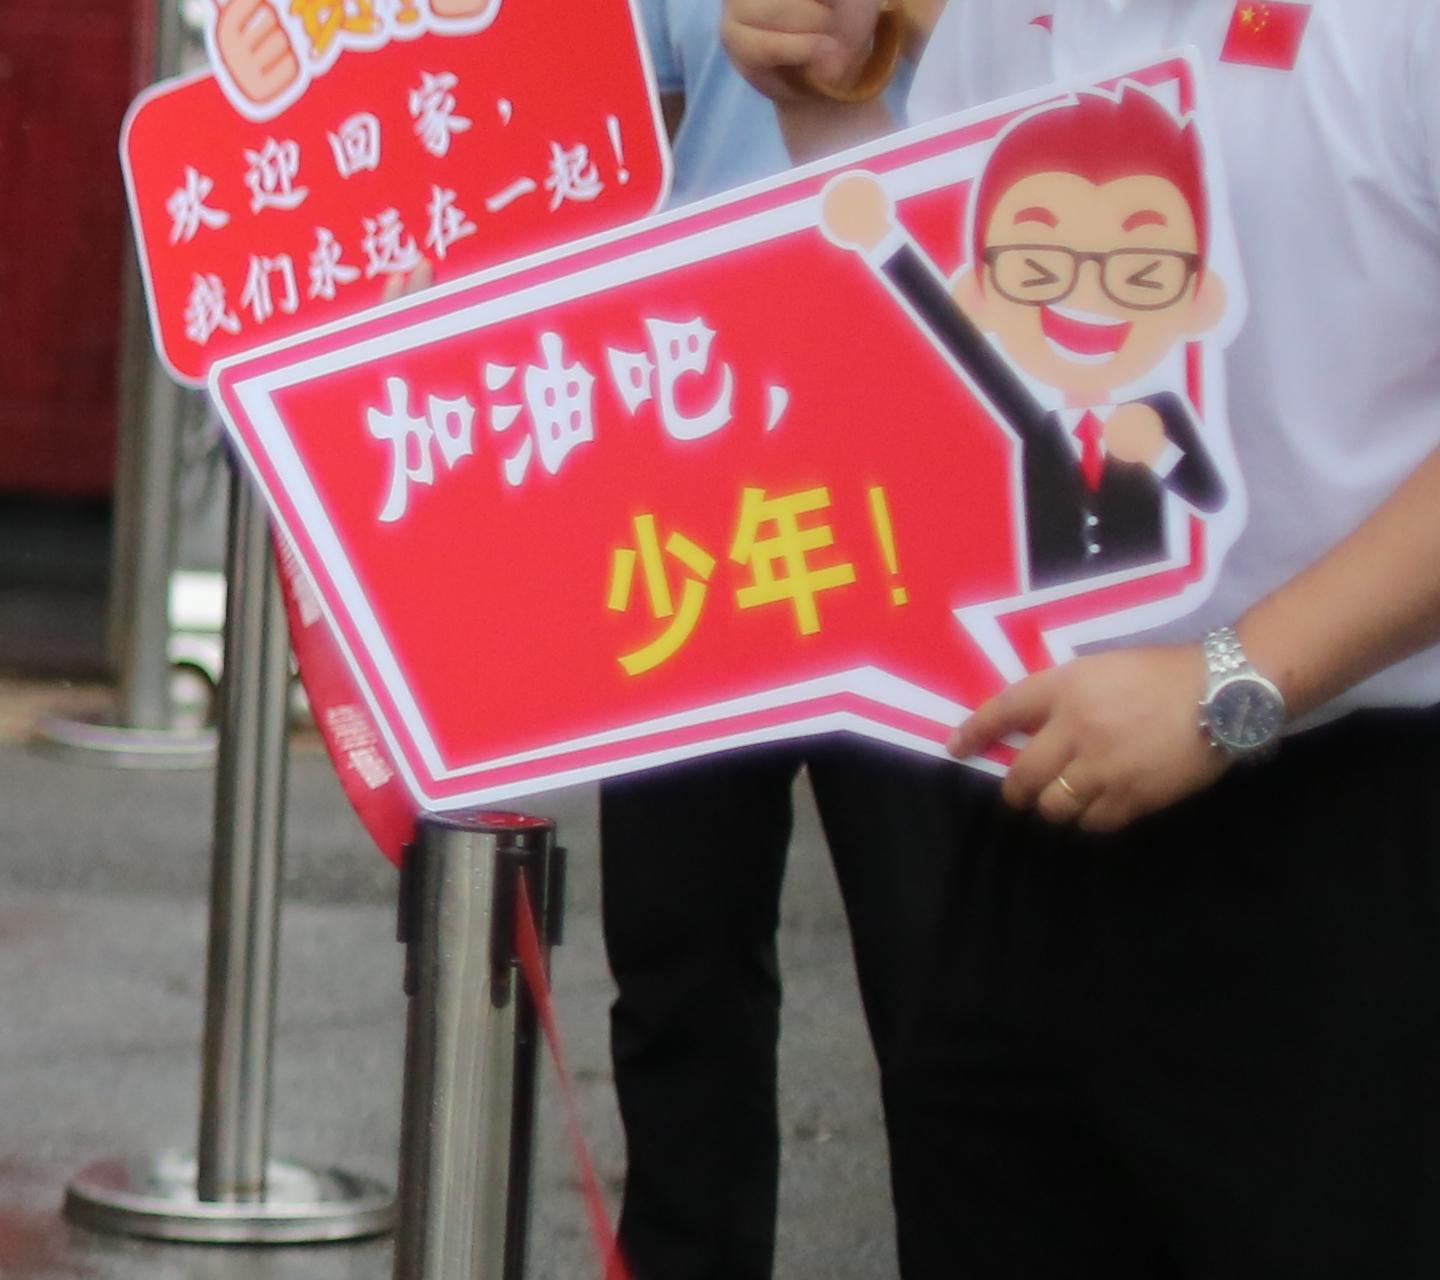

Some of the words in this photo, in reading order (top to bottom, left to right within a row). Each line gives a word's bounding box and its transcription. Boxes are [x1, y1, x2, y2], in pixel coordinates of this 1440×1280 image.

[367, 317, 790, 523] 加油吧，
[607, 486, 909, 677] 少年！
